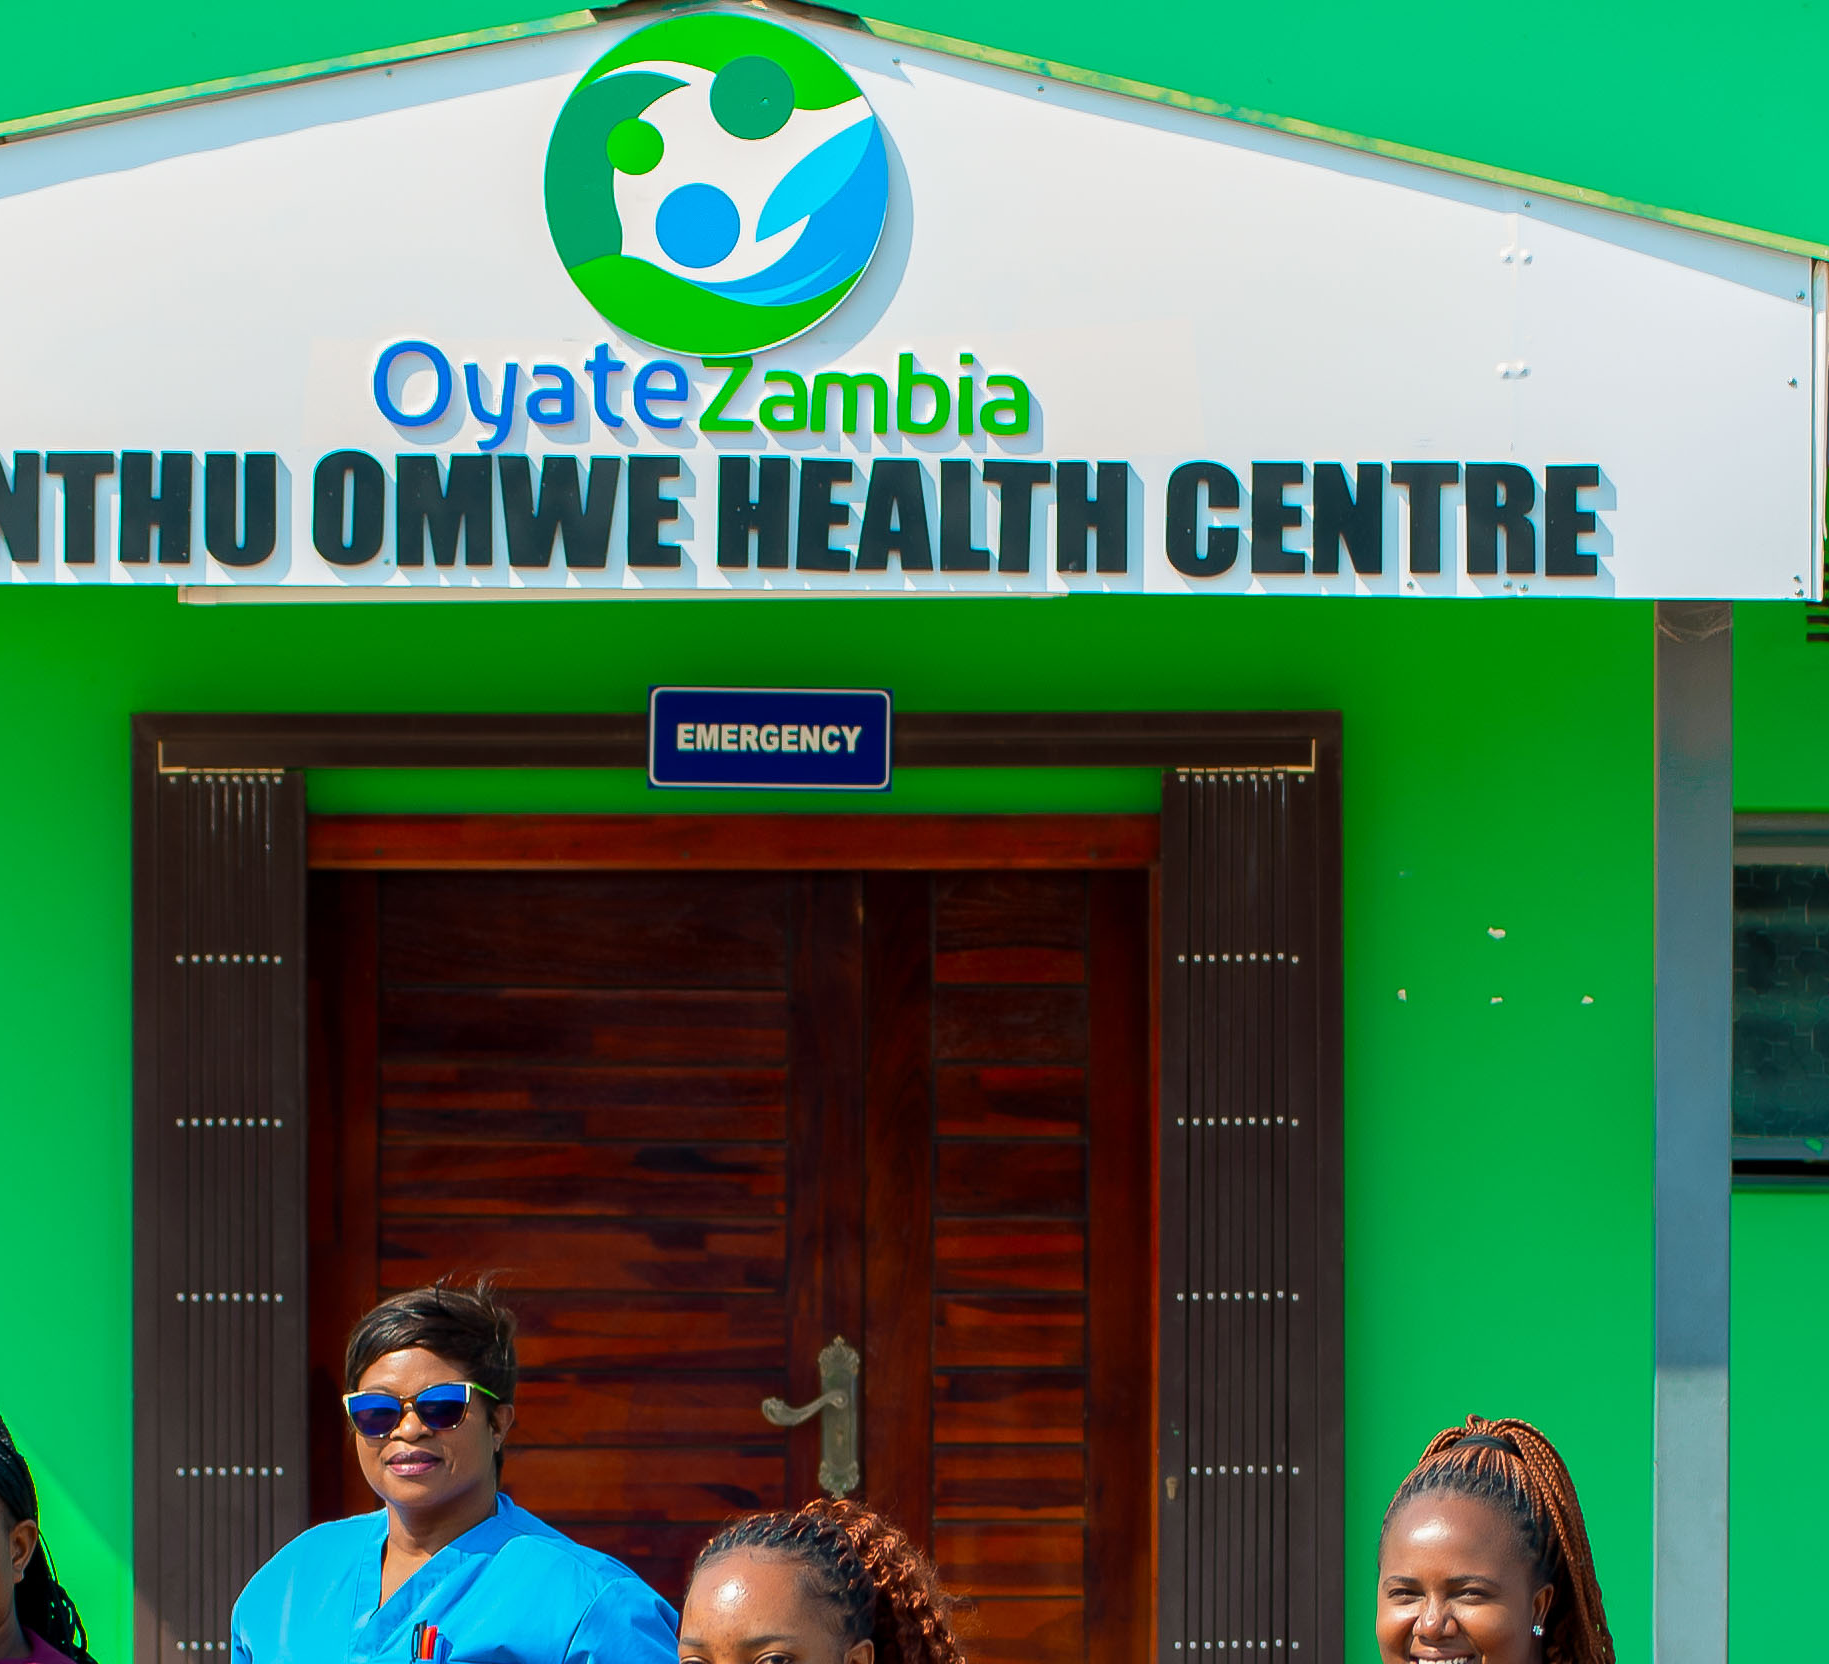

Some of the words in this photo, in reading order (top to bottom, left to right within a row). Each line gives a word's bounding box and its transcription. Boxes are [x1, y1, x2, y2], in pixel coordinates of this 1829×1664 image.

[312, 449, 682, 569] OMWE
[716, 456, 1129, 574] HEALTH
[1164, 461, 1600, 577] CENTRE
[677, 723, 862, 752] EMERGENCY
